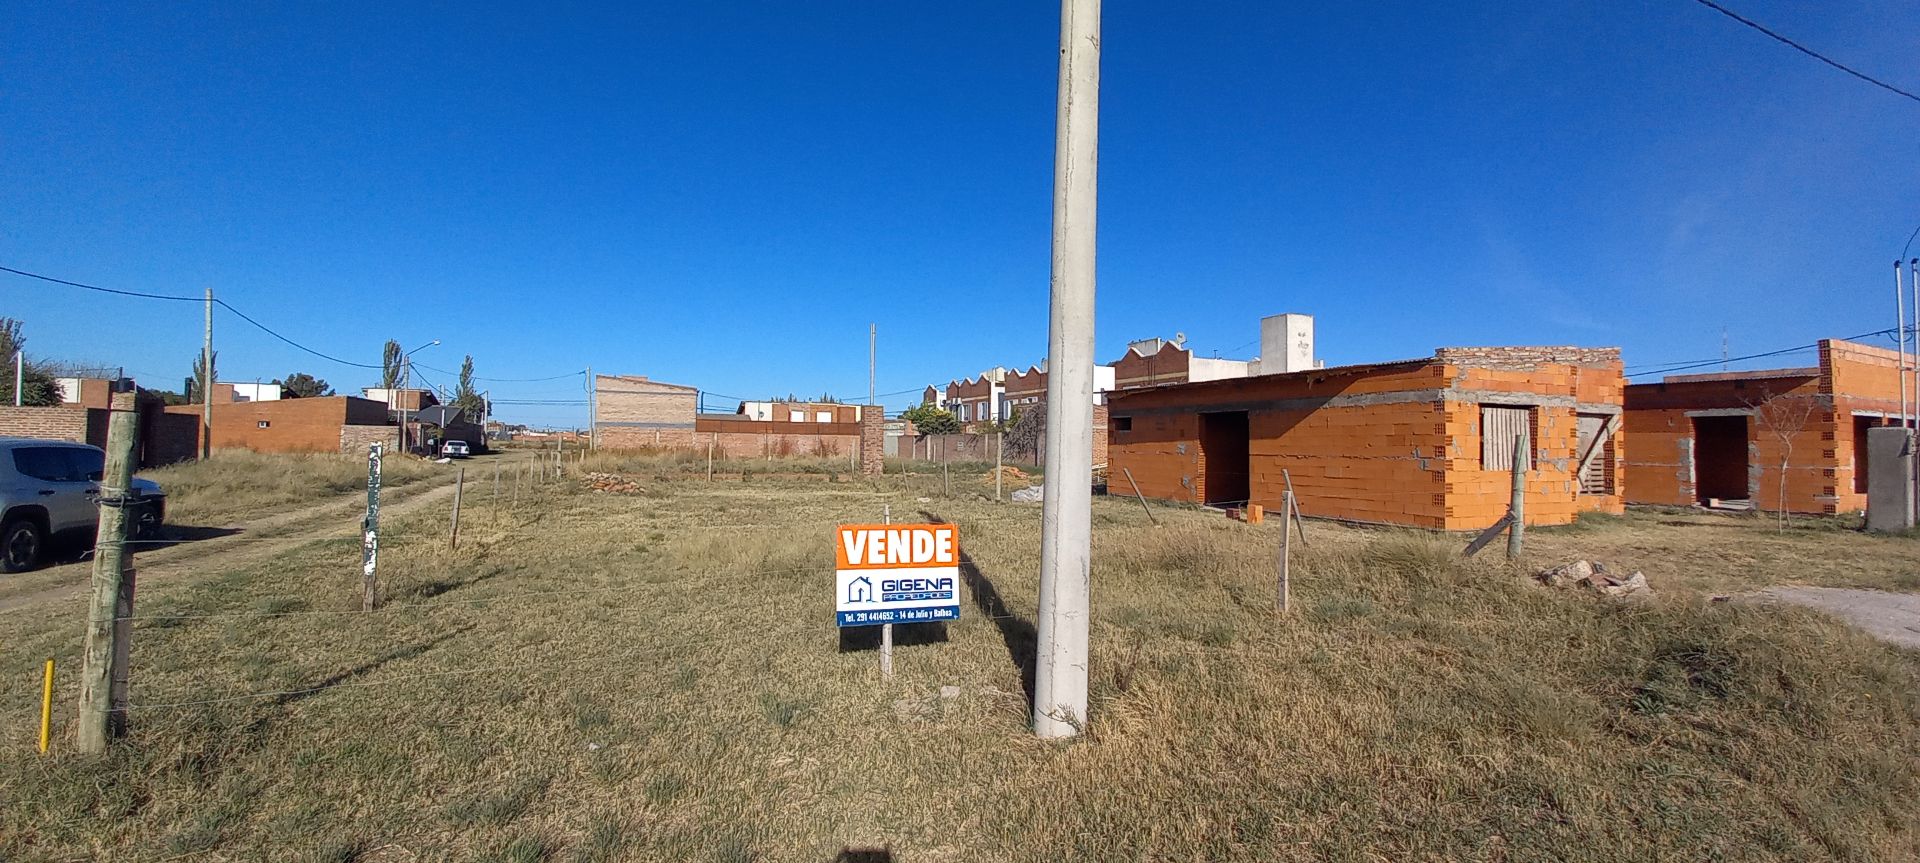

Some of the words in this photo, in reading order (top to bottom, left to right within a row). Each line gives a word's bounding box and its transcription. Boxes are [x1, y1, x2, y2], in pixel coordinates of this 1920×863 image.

[841, 529, 952, 565] VENDE
[881, 578, 953, 592] GIGENA
[844, 613, 856, 623] Tel.
[856, 612, 868, 622] 291
[869, 611, 894, 621] 4414652
[899, 610, 906, 620] 14
[907, 610, 915, 619] de
[928, 610, 933, 619] y
